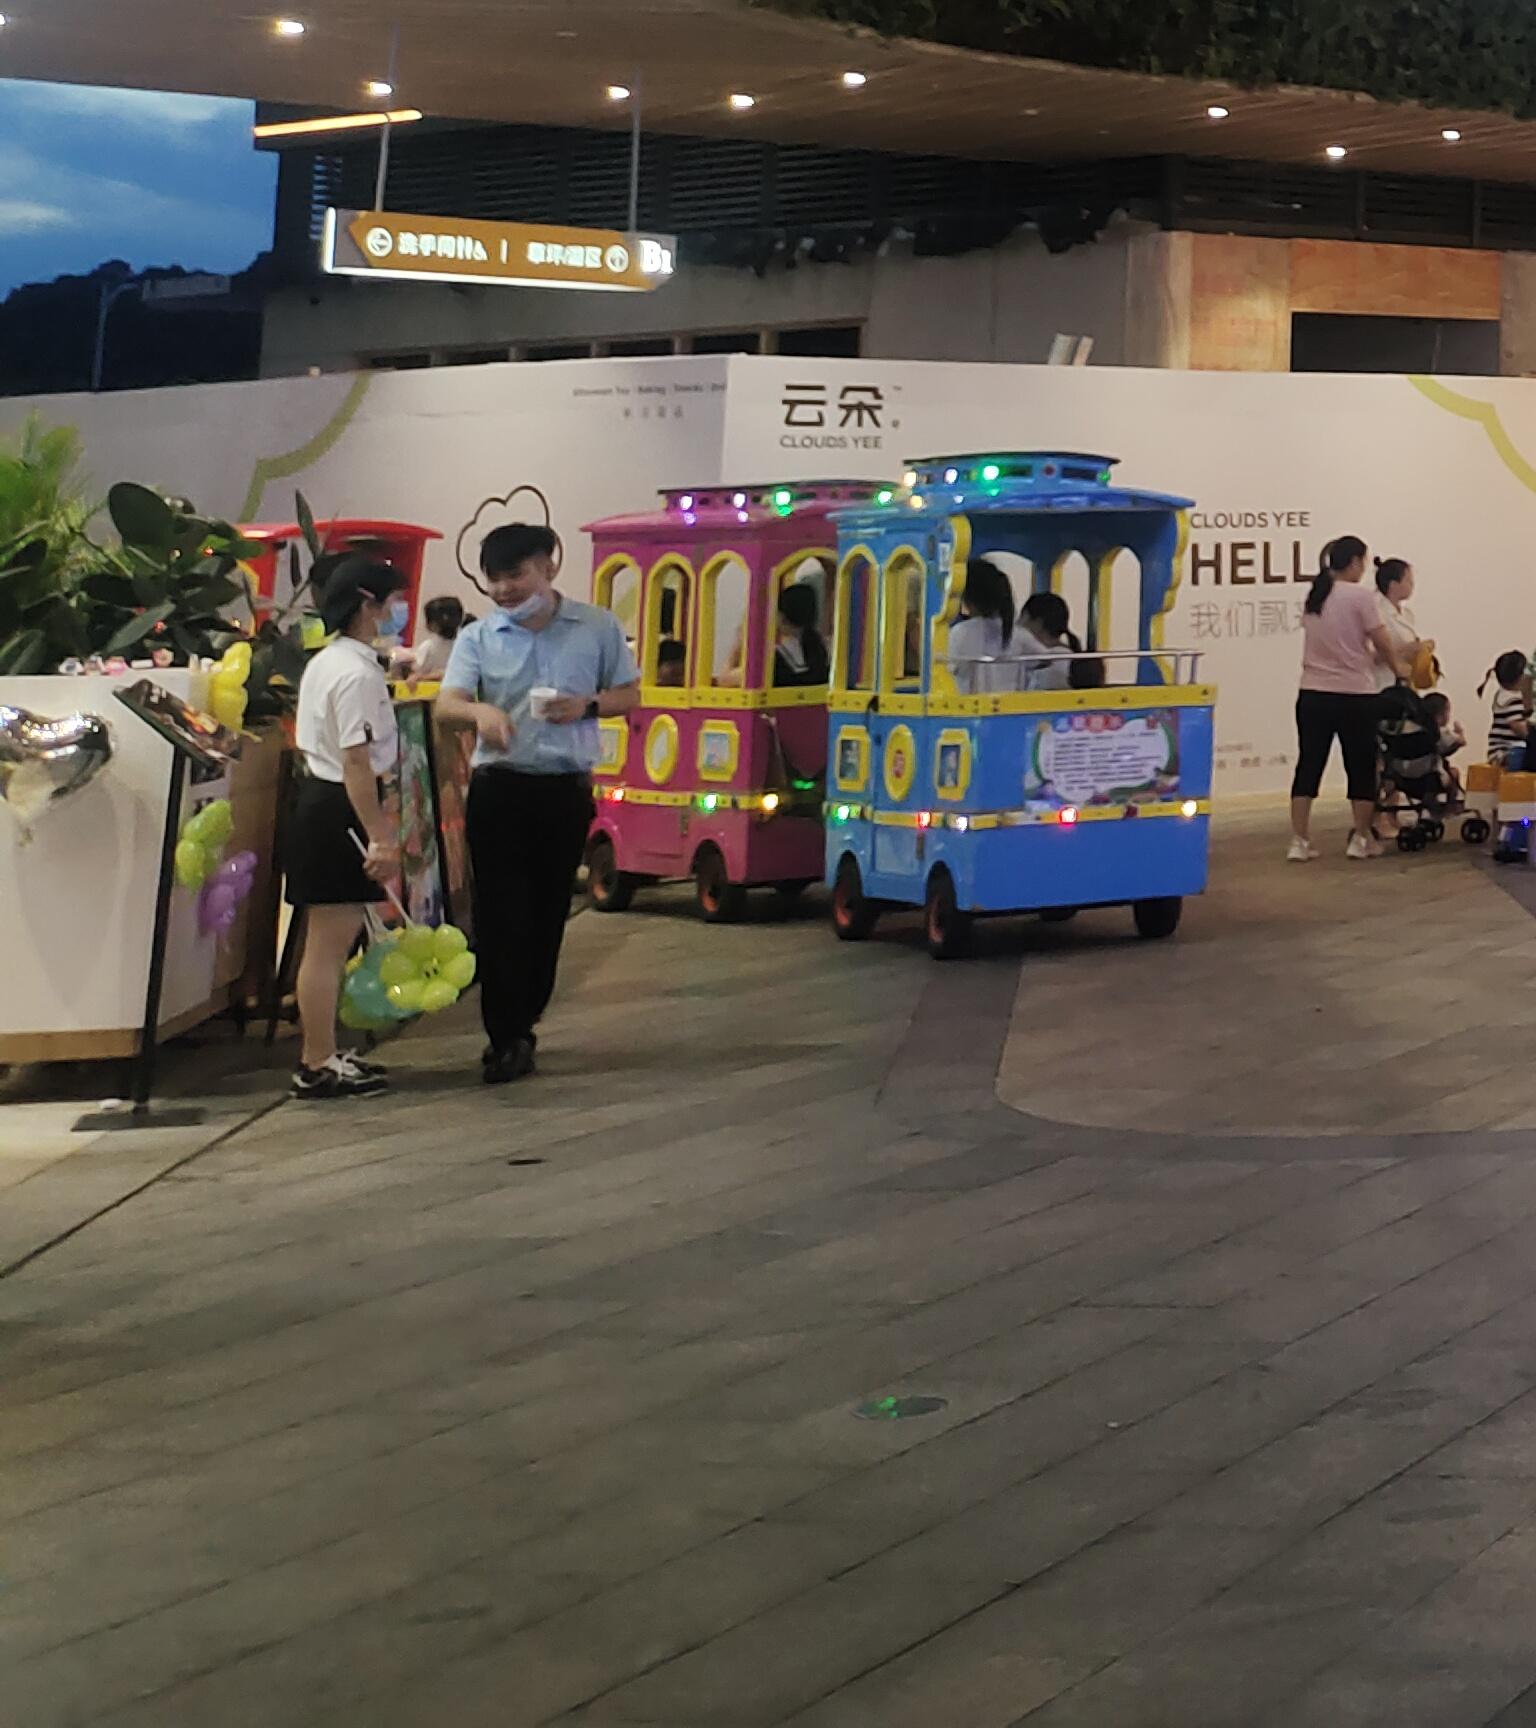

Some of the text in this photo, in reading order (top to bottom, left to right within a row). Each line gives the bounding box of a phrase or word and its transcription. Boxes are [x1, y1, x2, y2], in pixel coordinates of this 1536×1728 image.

[639, 239, 674, 275] B1
[781, 384, 884, 429] 云朵
[779, 434, 883, 450] CLOUDS YEE
[1190, 511, 1312, 529] CLOUDS YEE
